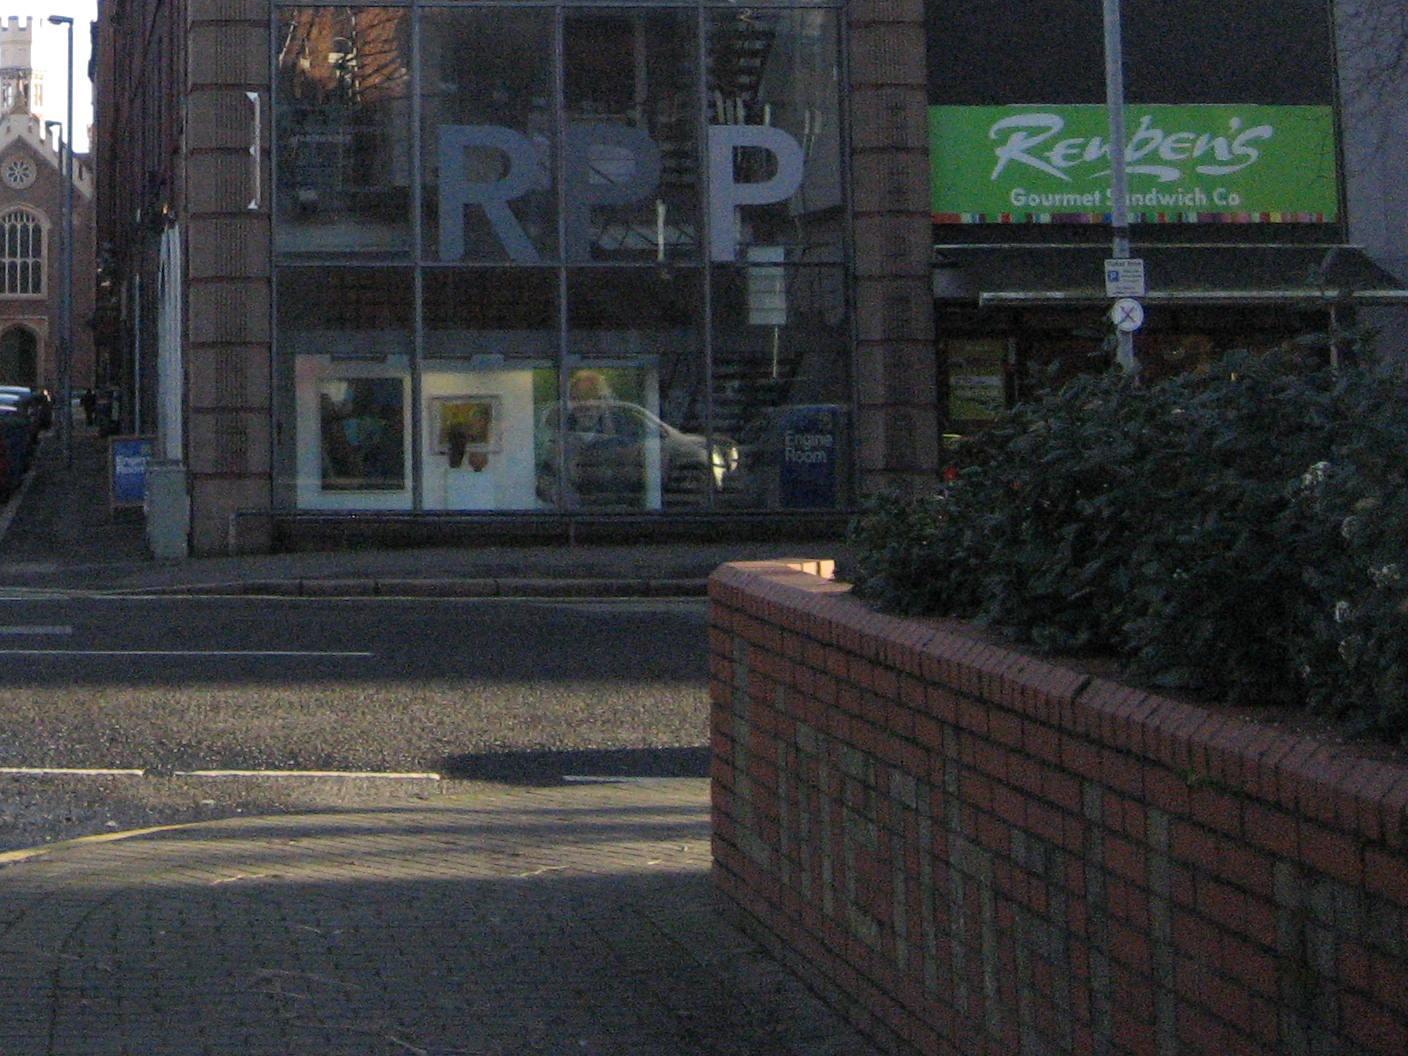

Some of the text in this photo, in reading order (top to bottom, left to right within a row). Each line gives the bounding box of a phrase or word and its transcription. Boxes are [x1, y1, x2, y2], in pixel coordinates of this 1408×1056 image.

[1010, 187, 1101, 207] Gourmet
[1212, 187, 1241, 207] Co
[784, 430, 833, 451] Engine
[784, 447, 828, 463] Room
